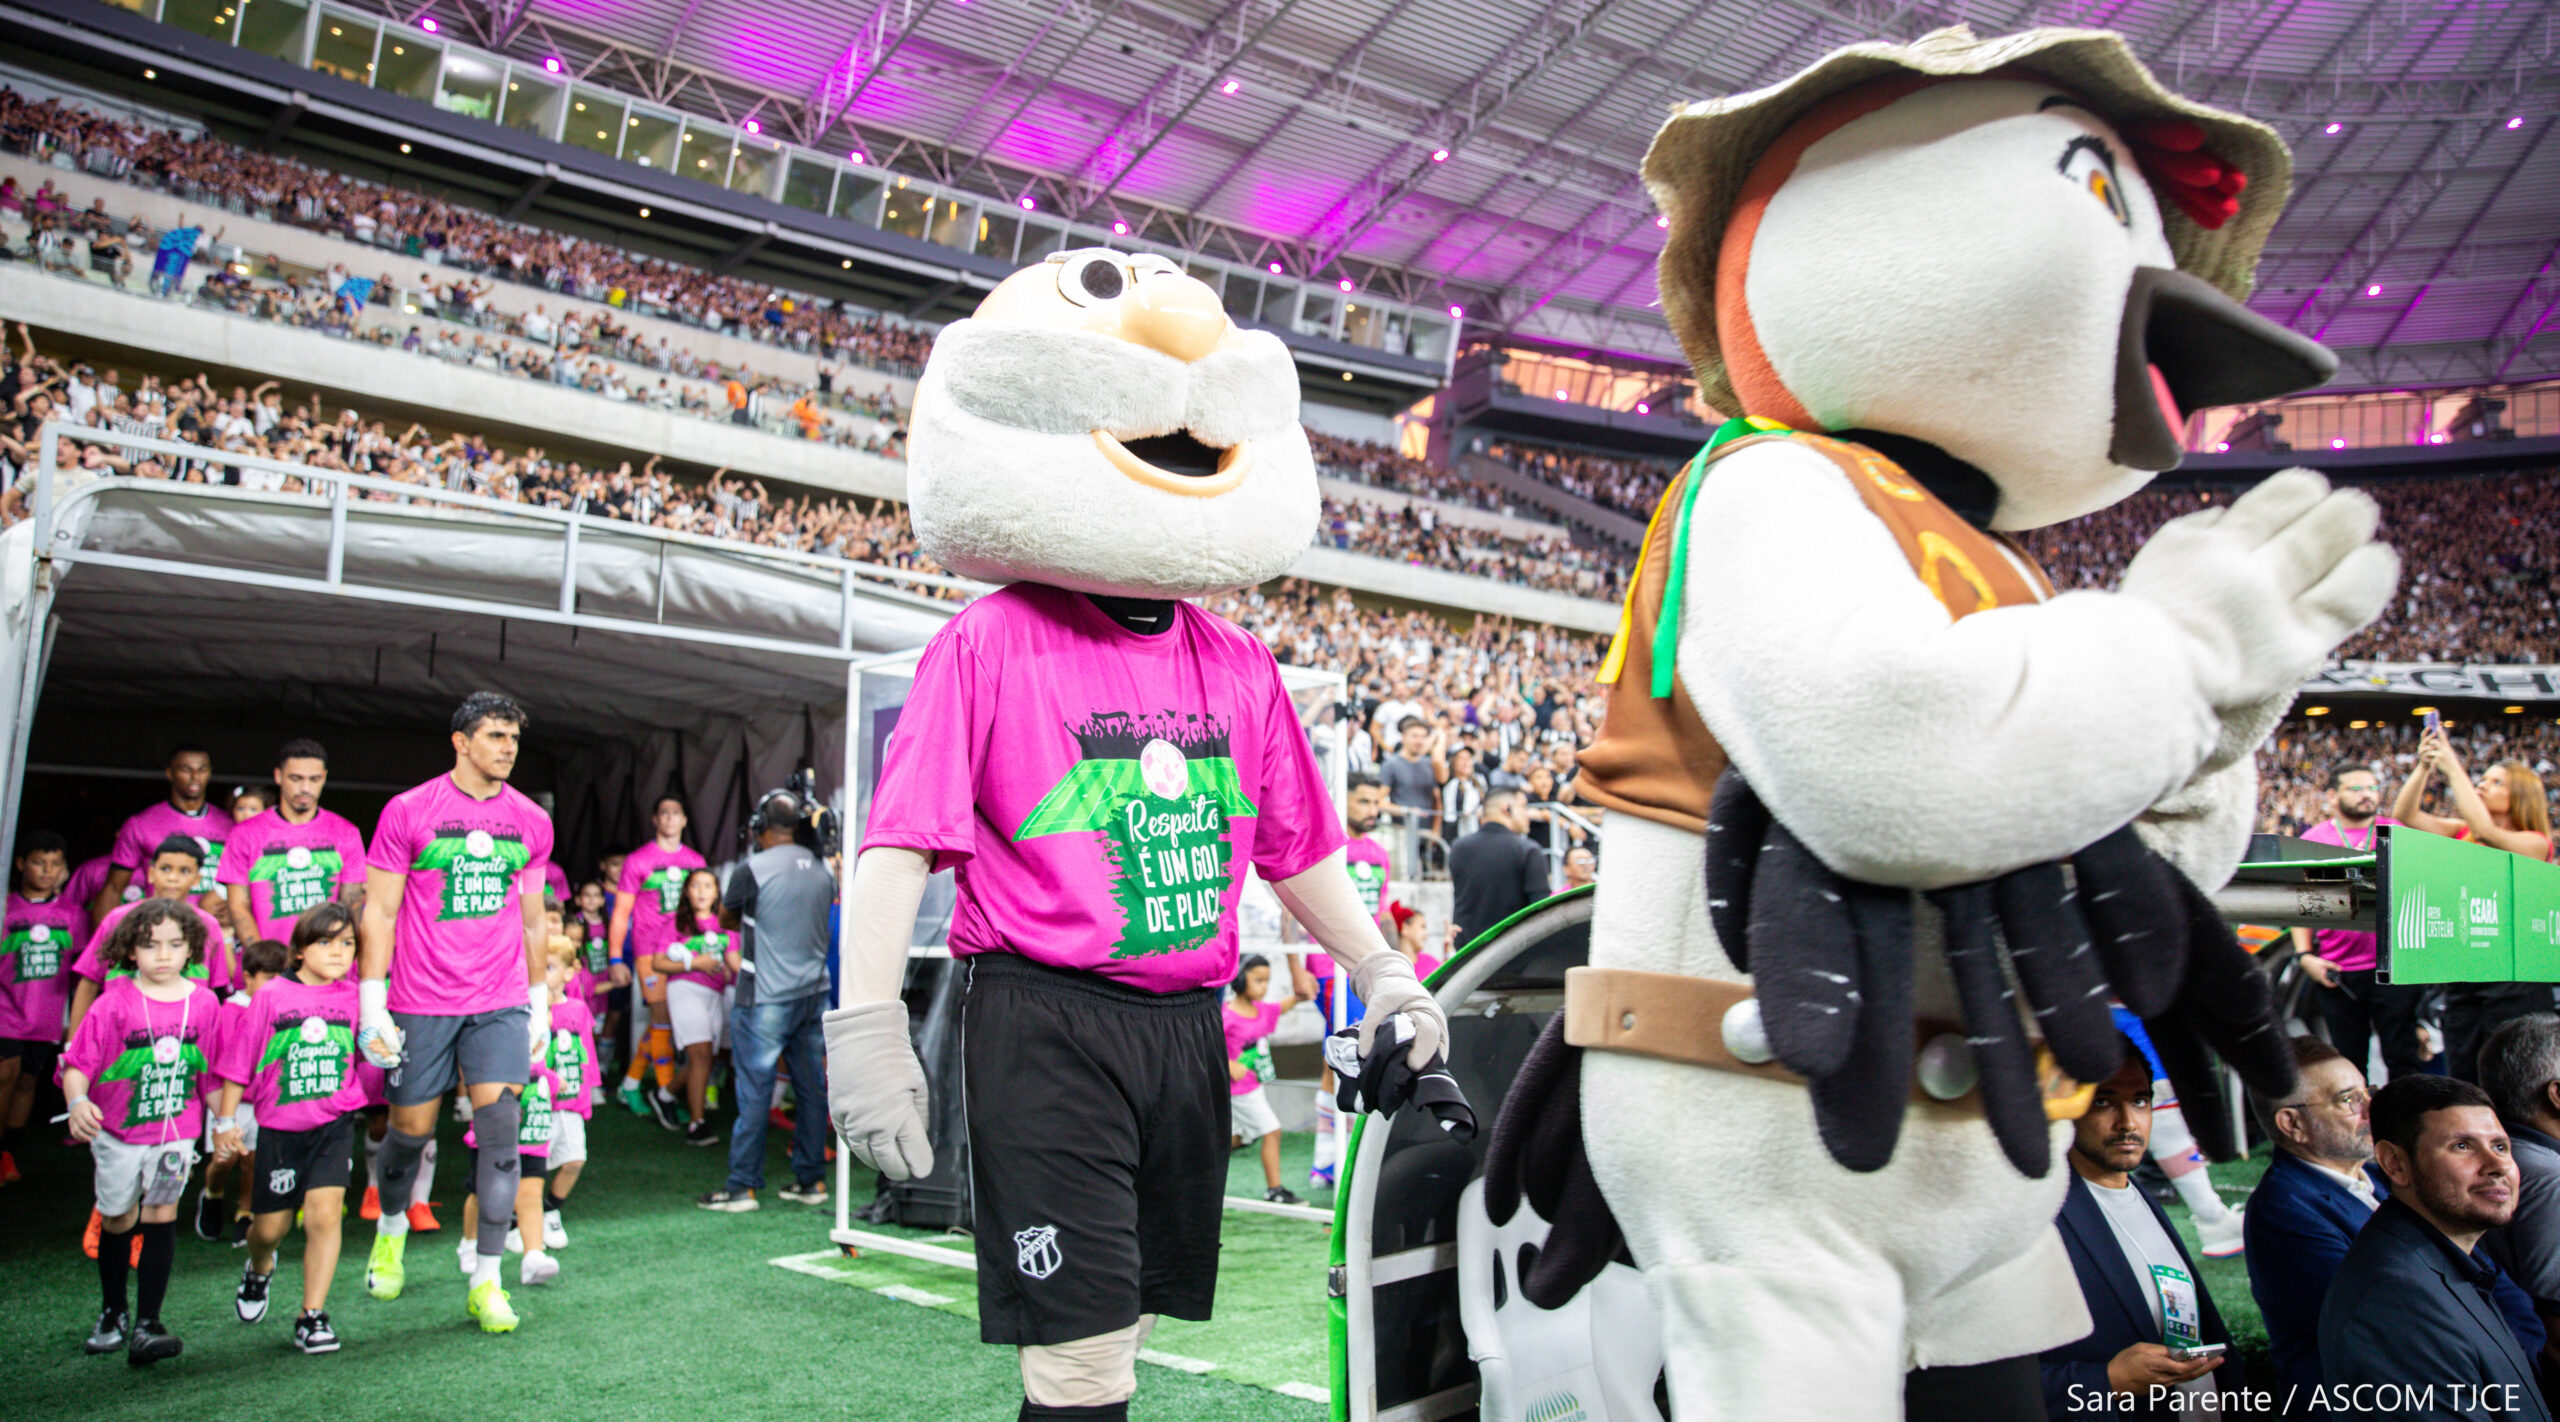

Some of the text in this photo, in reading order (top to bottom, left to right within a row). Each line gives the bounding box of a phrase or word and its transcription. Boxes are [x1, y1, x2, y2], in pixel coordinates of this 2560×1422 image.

[1125, 794, 1218, 849] Respeito
[452, 854, 508, 878] Respeito
[1139, 846, 1156, 888] É
[1158, 848, 1190, 886] UM
[465, 876, 483, 894] UM
[453, 895, 468, 913] DE
[1145, 896, 1175, 933] DE
[2469, 890, 2498, 925] CEARÁ
[288, 1039, 341, 1062] Respeito
[300, 1060, 317, 1077] UM
[289, 1079, 304, 1096] DE
